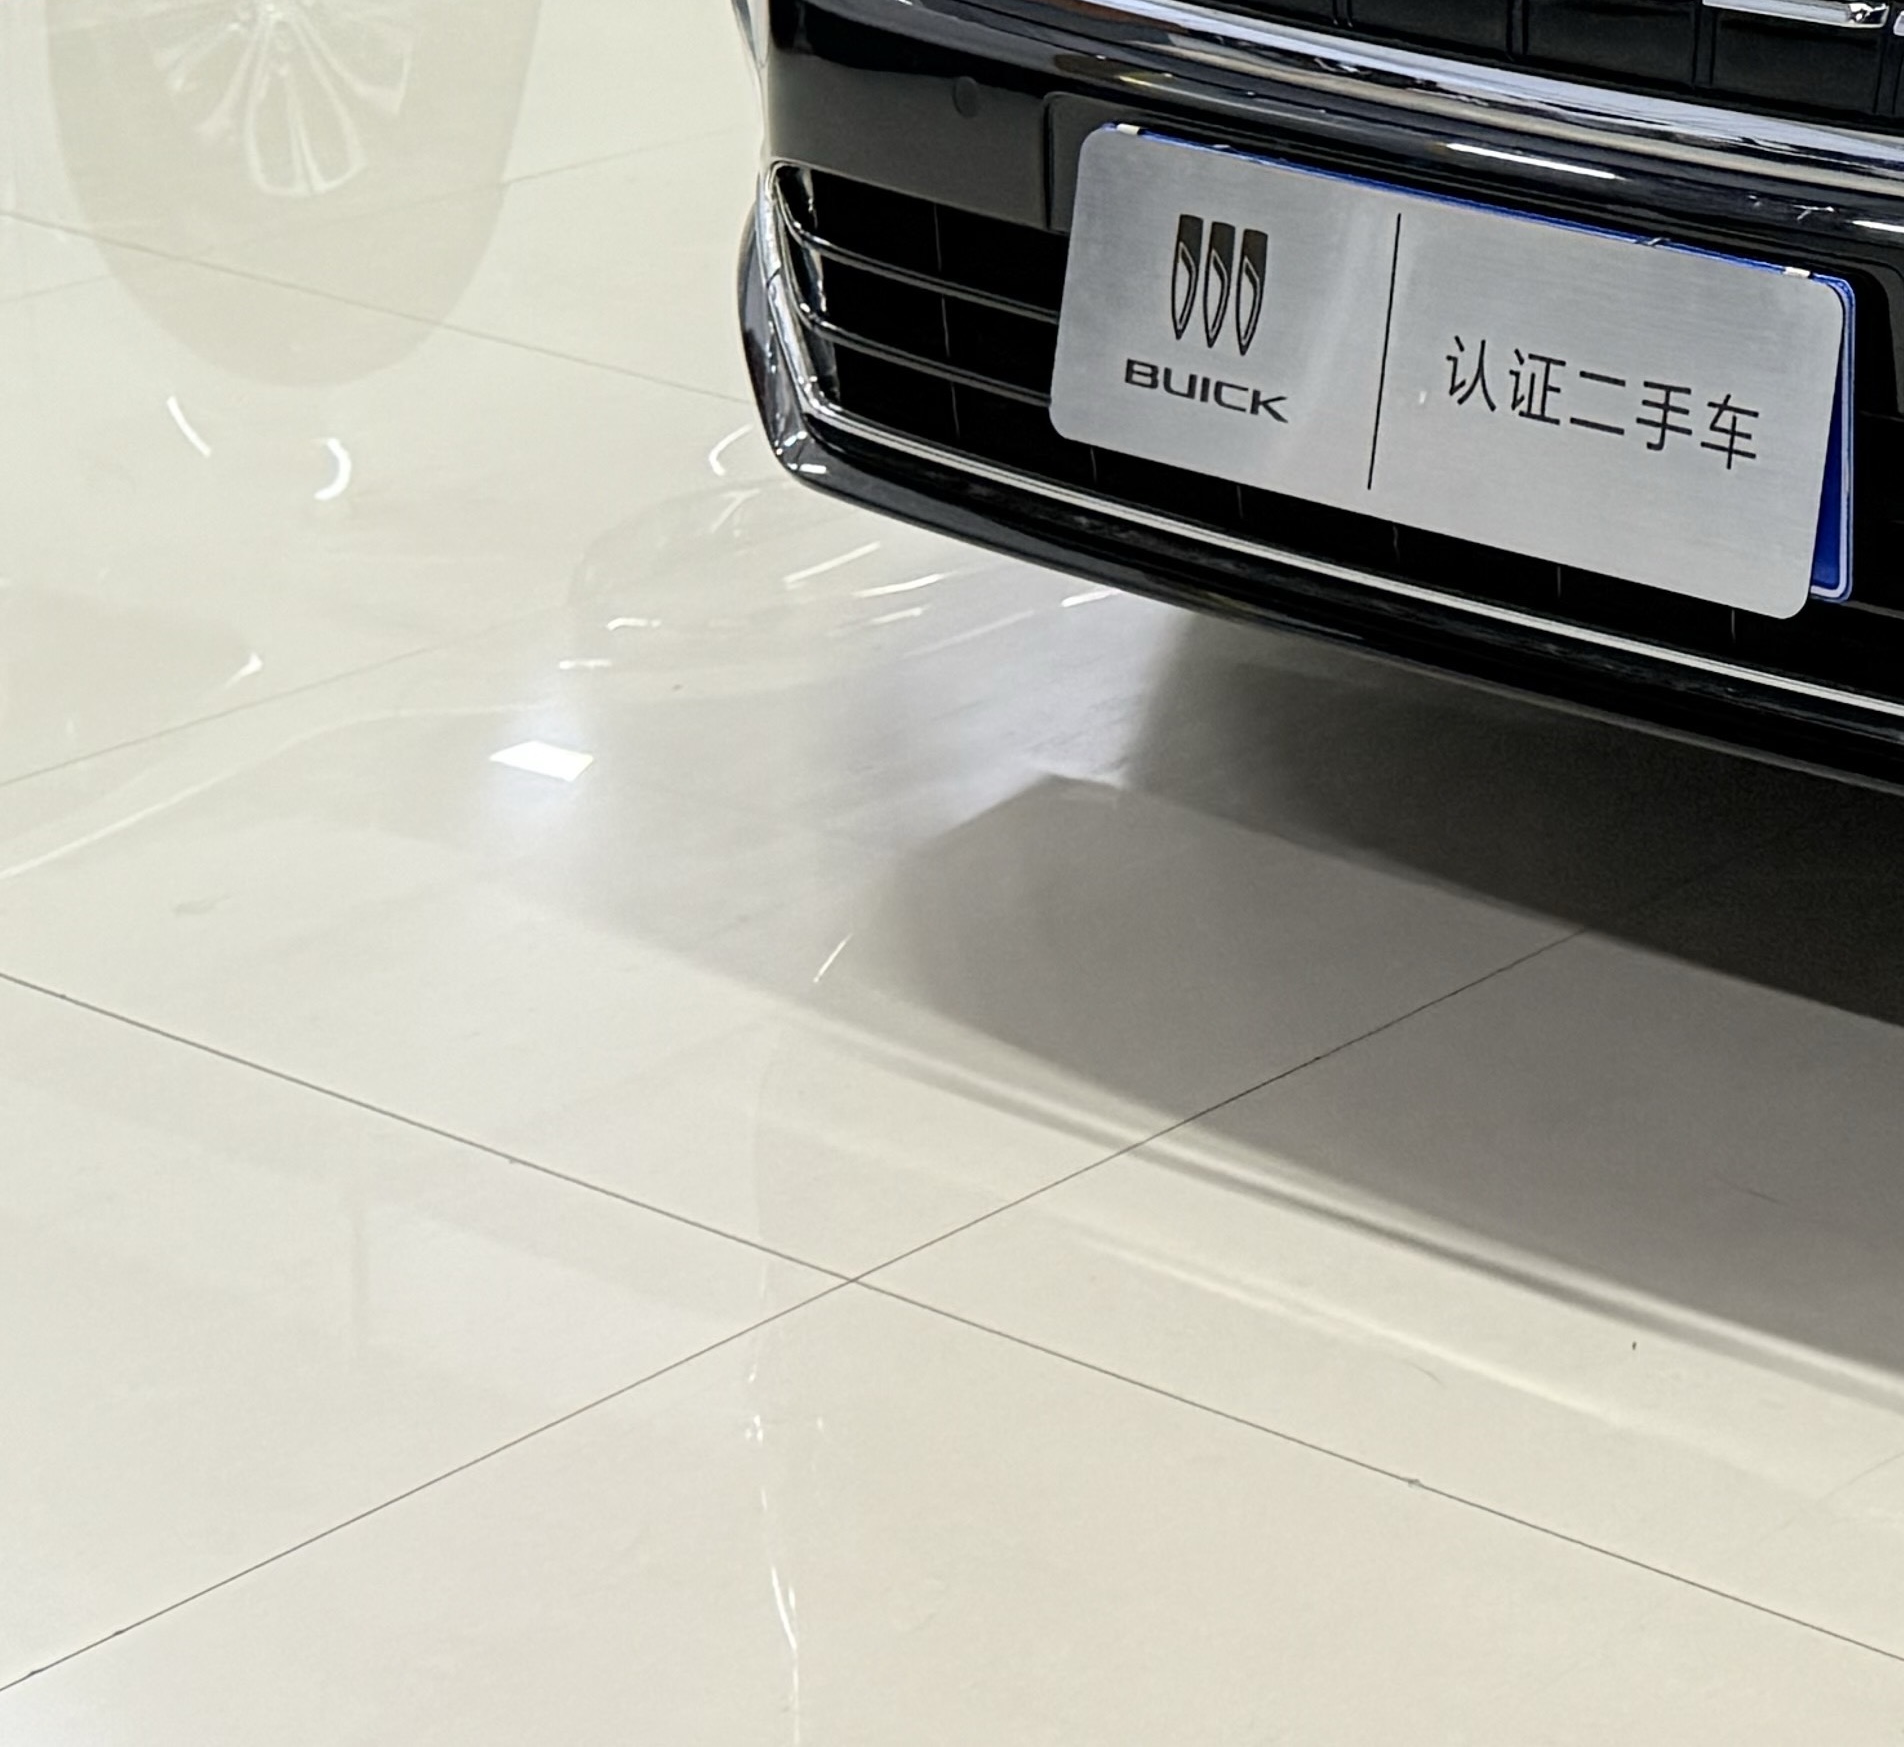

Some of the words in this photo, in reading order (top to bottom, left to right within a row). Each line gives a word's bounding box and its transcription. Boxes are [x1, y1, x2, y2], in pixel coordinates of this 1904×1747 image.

[1123, 358, 1289, 424] BUICK
[1445, 336, 1760, 470] 认证二手车
